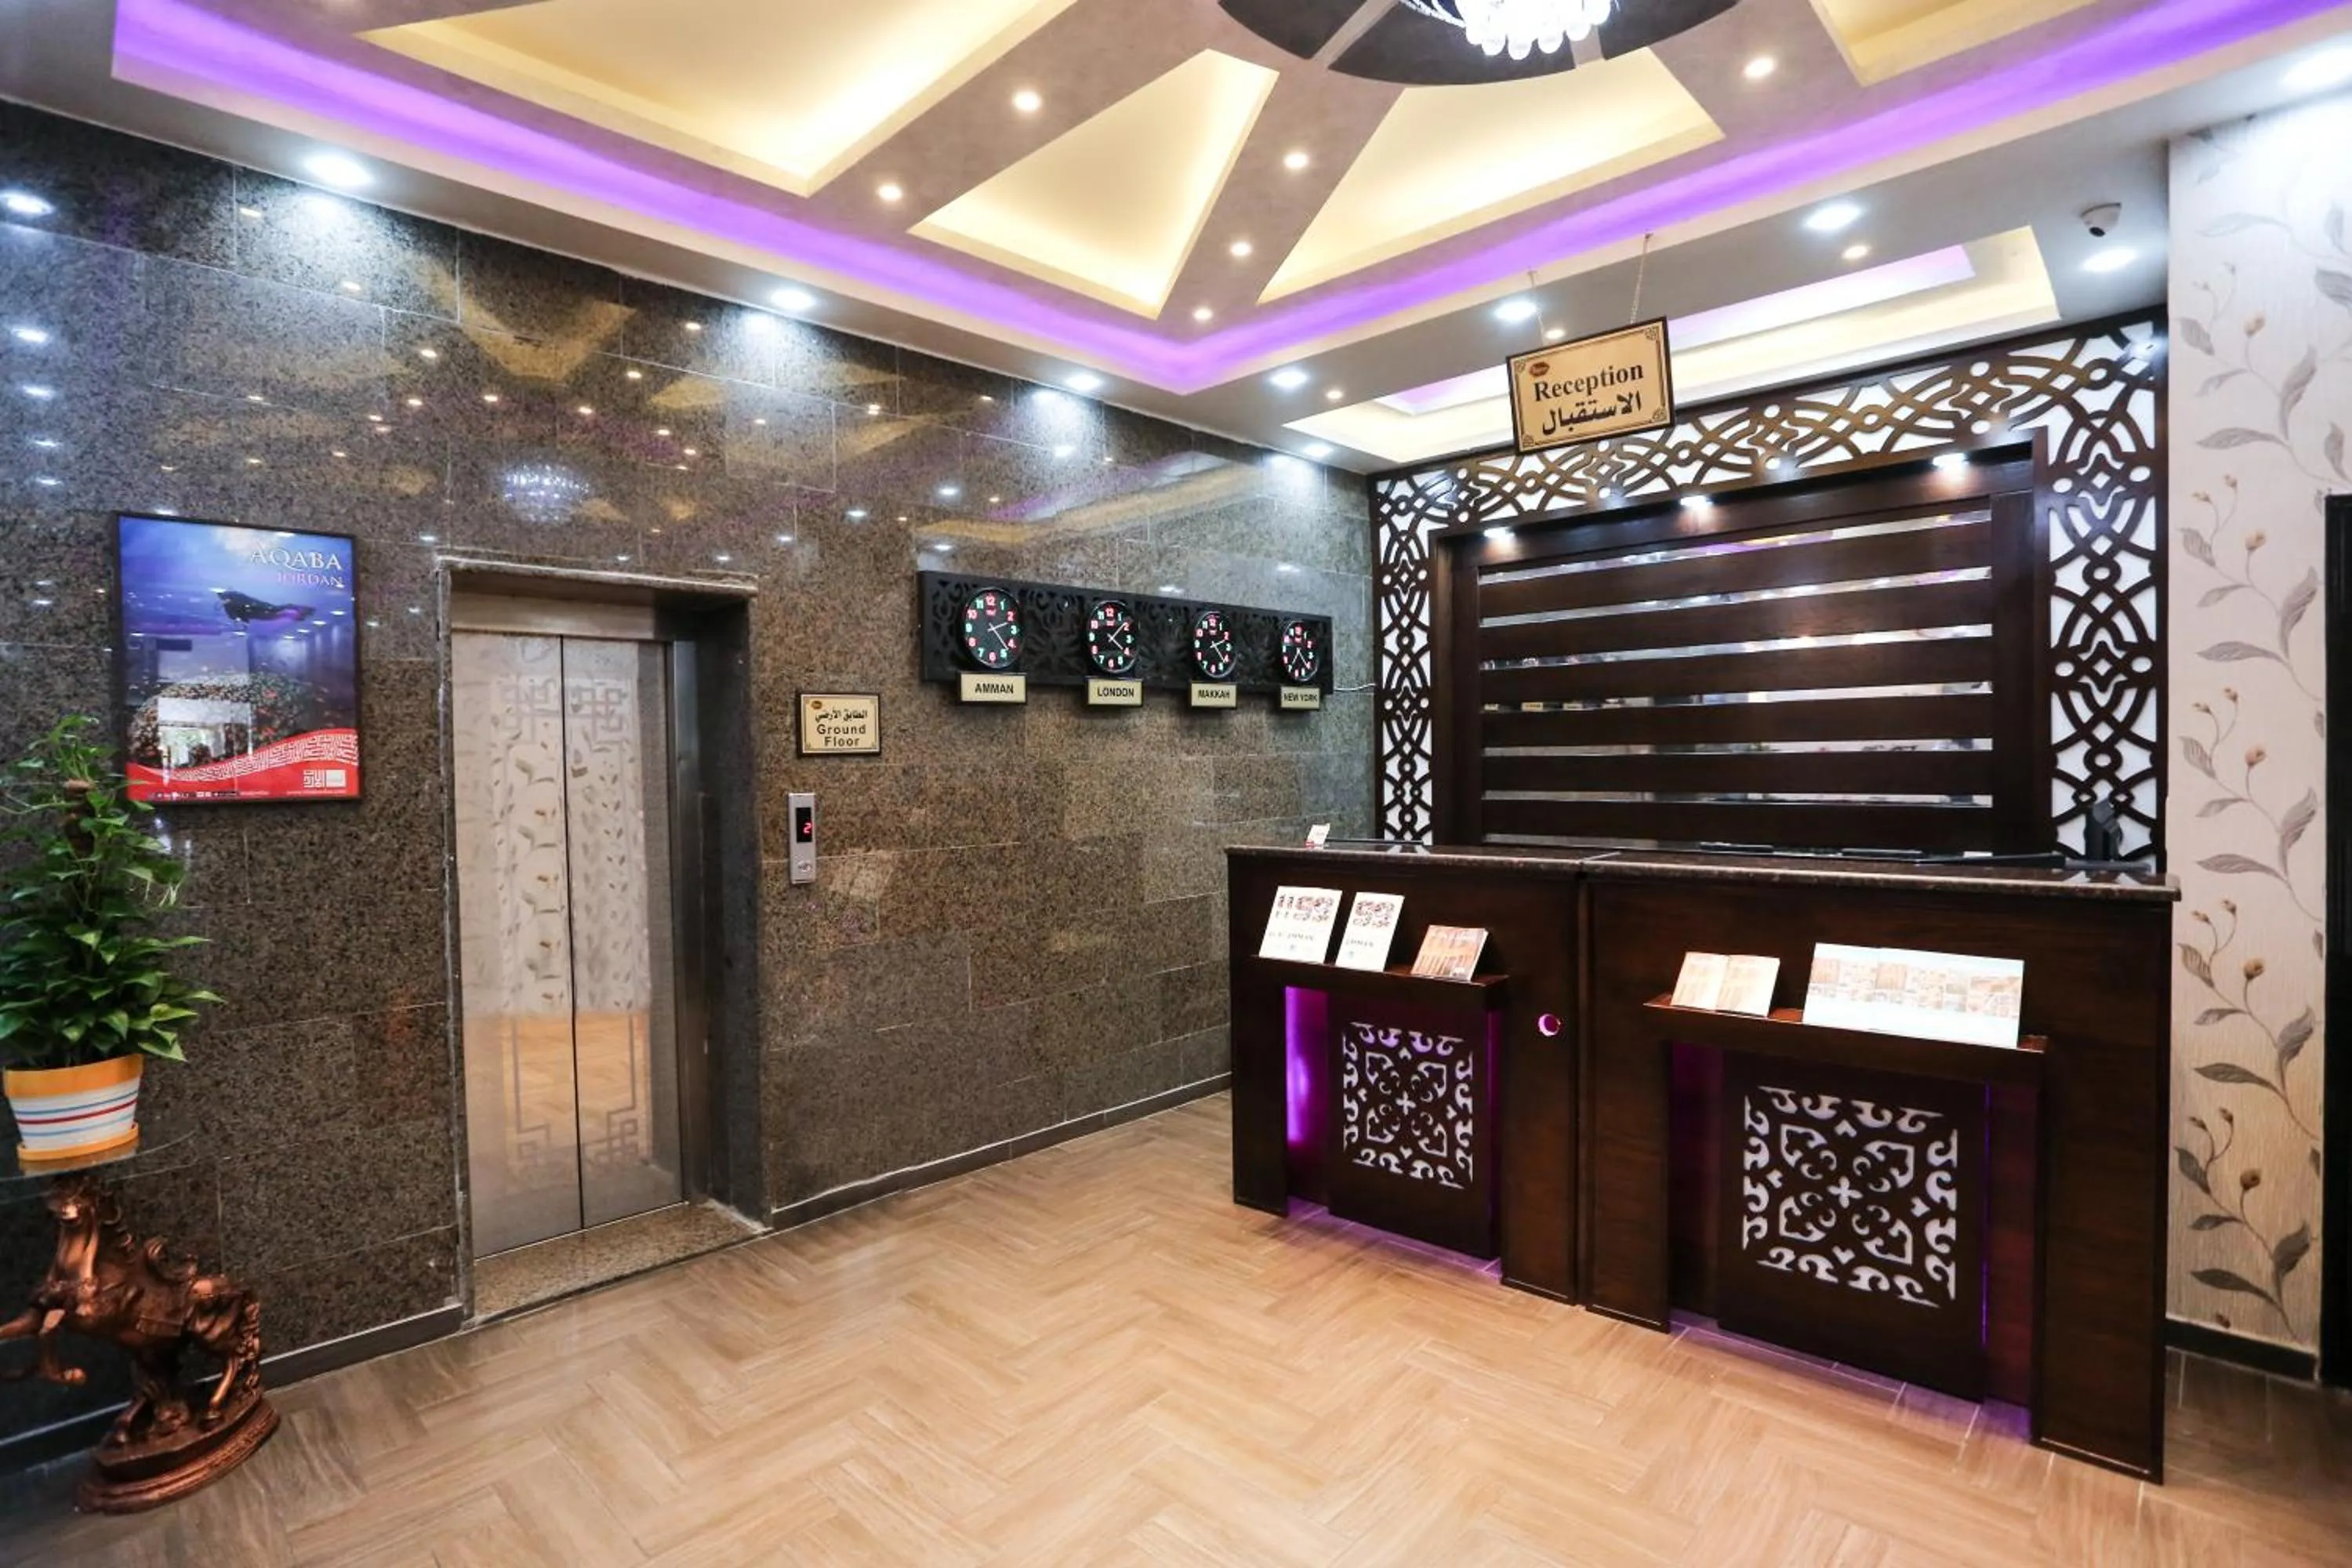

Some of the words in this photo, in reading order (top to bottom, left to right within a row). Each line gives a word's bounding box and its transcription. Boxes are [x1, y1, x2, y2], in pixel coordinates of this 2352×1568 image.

[1534, 365, 1644, 401] Reception
[1542, 390, 1642, 436] الاستقبال
[250, 543, 343, 571] AQABA
[1000, 599, 1005, 611] 1
[1007, 611, 1014, 622] 2
[1011, 625, 1017, 635] 3
[1007, 638, 1015, 648] 4
[978, 648, 985, 658] 7
[975, 683, 1014, 694] AMMAN
[1098, 688, 1134, 697] LONDON
[1198, 689, 1230, 699] MAKKAH
[1284, 693, 1298, 702] NEW
[816, 724, 866, 735] Ground
[824, 736, 860, 747] Floor
[803, 822, 812, 833] 2
